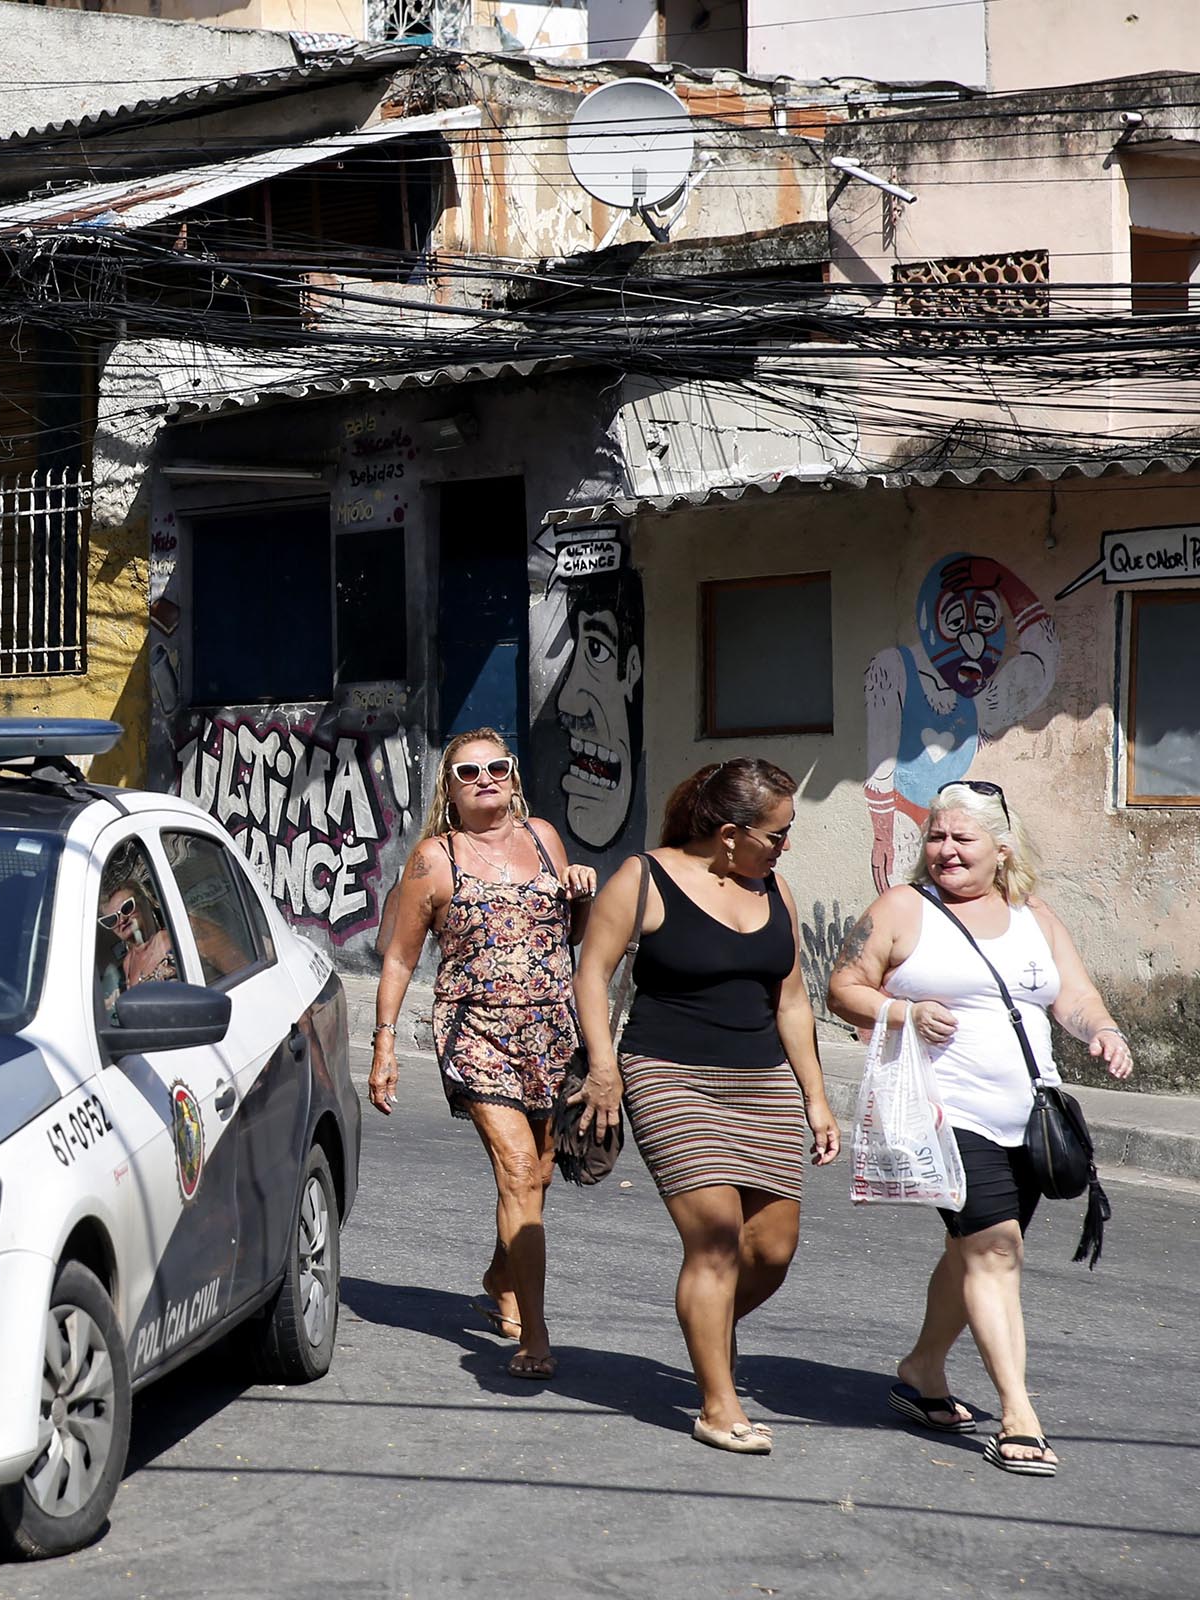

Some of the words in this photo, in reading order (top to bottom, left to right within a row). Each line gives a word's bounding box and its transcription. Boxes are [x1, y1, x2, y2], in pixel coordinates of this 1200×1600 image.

[349, 464, 404, 487] Bebidas
[563, 555, 615, 571] CHANCE
[234, 826, 369, 925] ANCE
[46, 1094, 113, 1166] 67-0952
[189, 1276, 220, 1332] CIVIL
